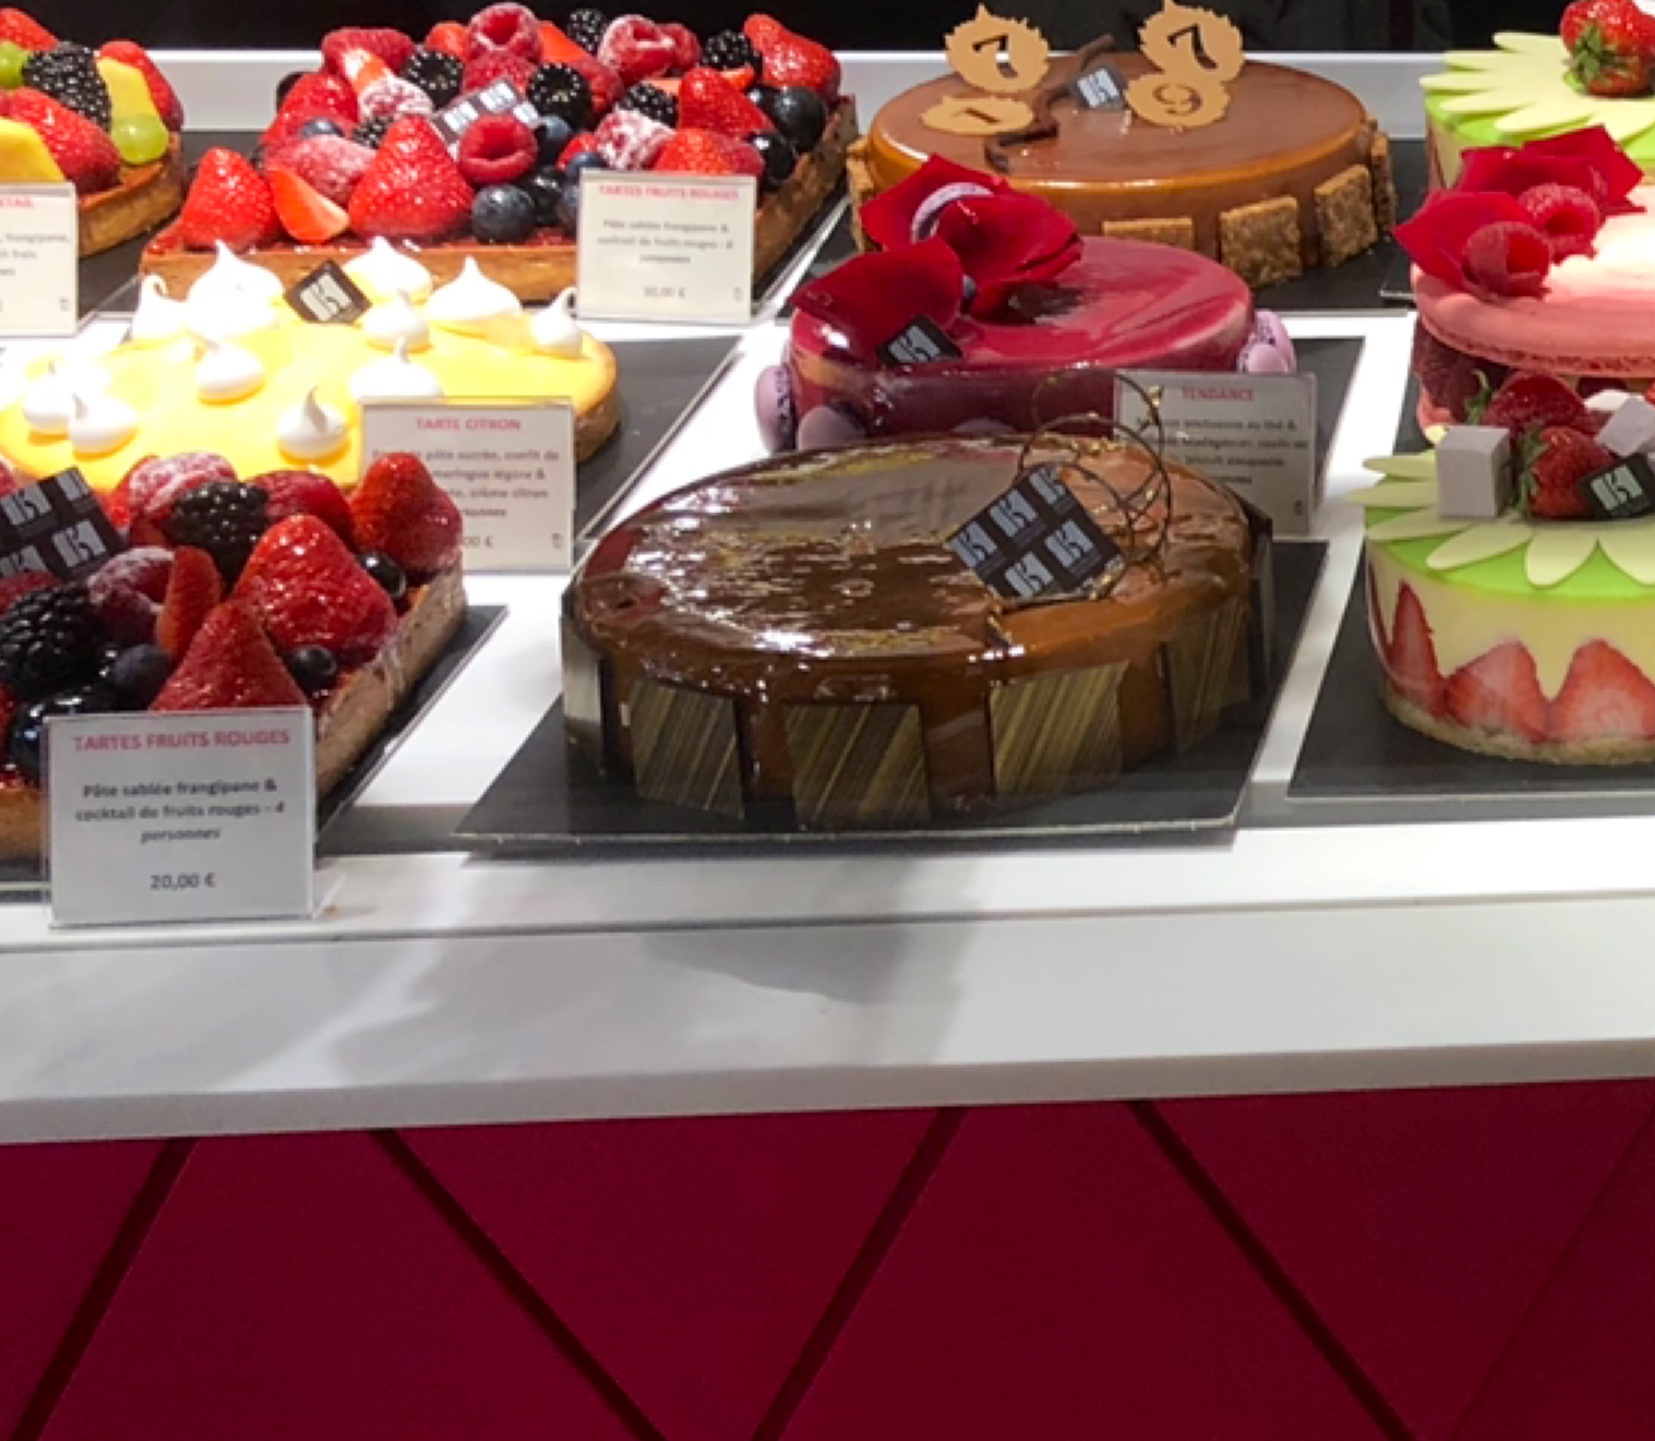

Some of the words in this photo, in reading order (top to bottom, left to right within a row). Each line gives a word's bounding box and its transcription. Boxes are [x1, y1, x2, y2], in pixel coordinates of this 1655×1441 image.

[1166, 23, 1219, 70] 7
[1182, 387, 1255, 401] TENDANCE
[416, 418, 460, 430] TARTE
[465, 418, 521, 431] CITRON
[73, 733, 142, 752] TARTES
[146, 731, 211, 750] FRUITS
[214, 728, 290, 747] ROUGES
[83, 782, 118, 799] Pâte
[122, 780, 172, 797] sablée
[176, 779, 260, 798] frangipane
[263, 777, 278, 792] &
[75, 806, 136, 823] cocktail
[138, 806, 158, 821] de
[162, 804, 205, 819] fruits
[207, 803, 260, 820] rouges
[139, 827, 221, 844] personnes
[150, 872, 200, 892] 20,00
[204, 872, 216, 888] €
